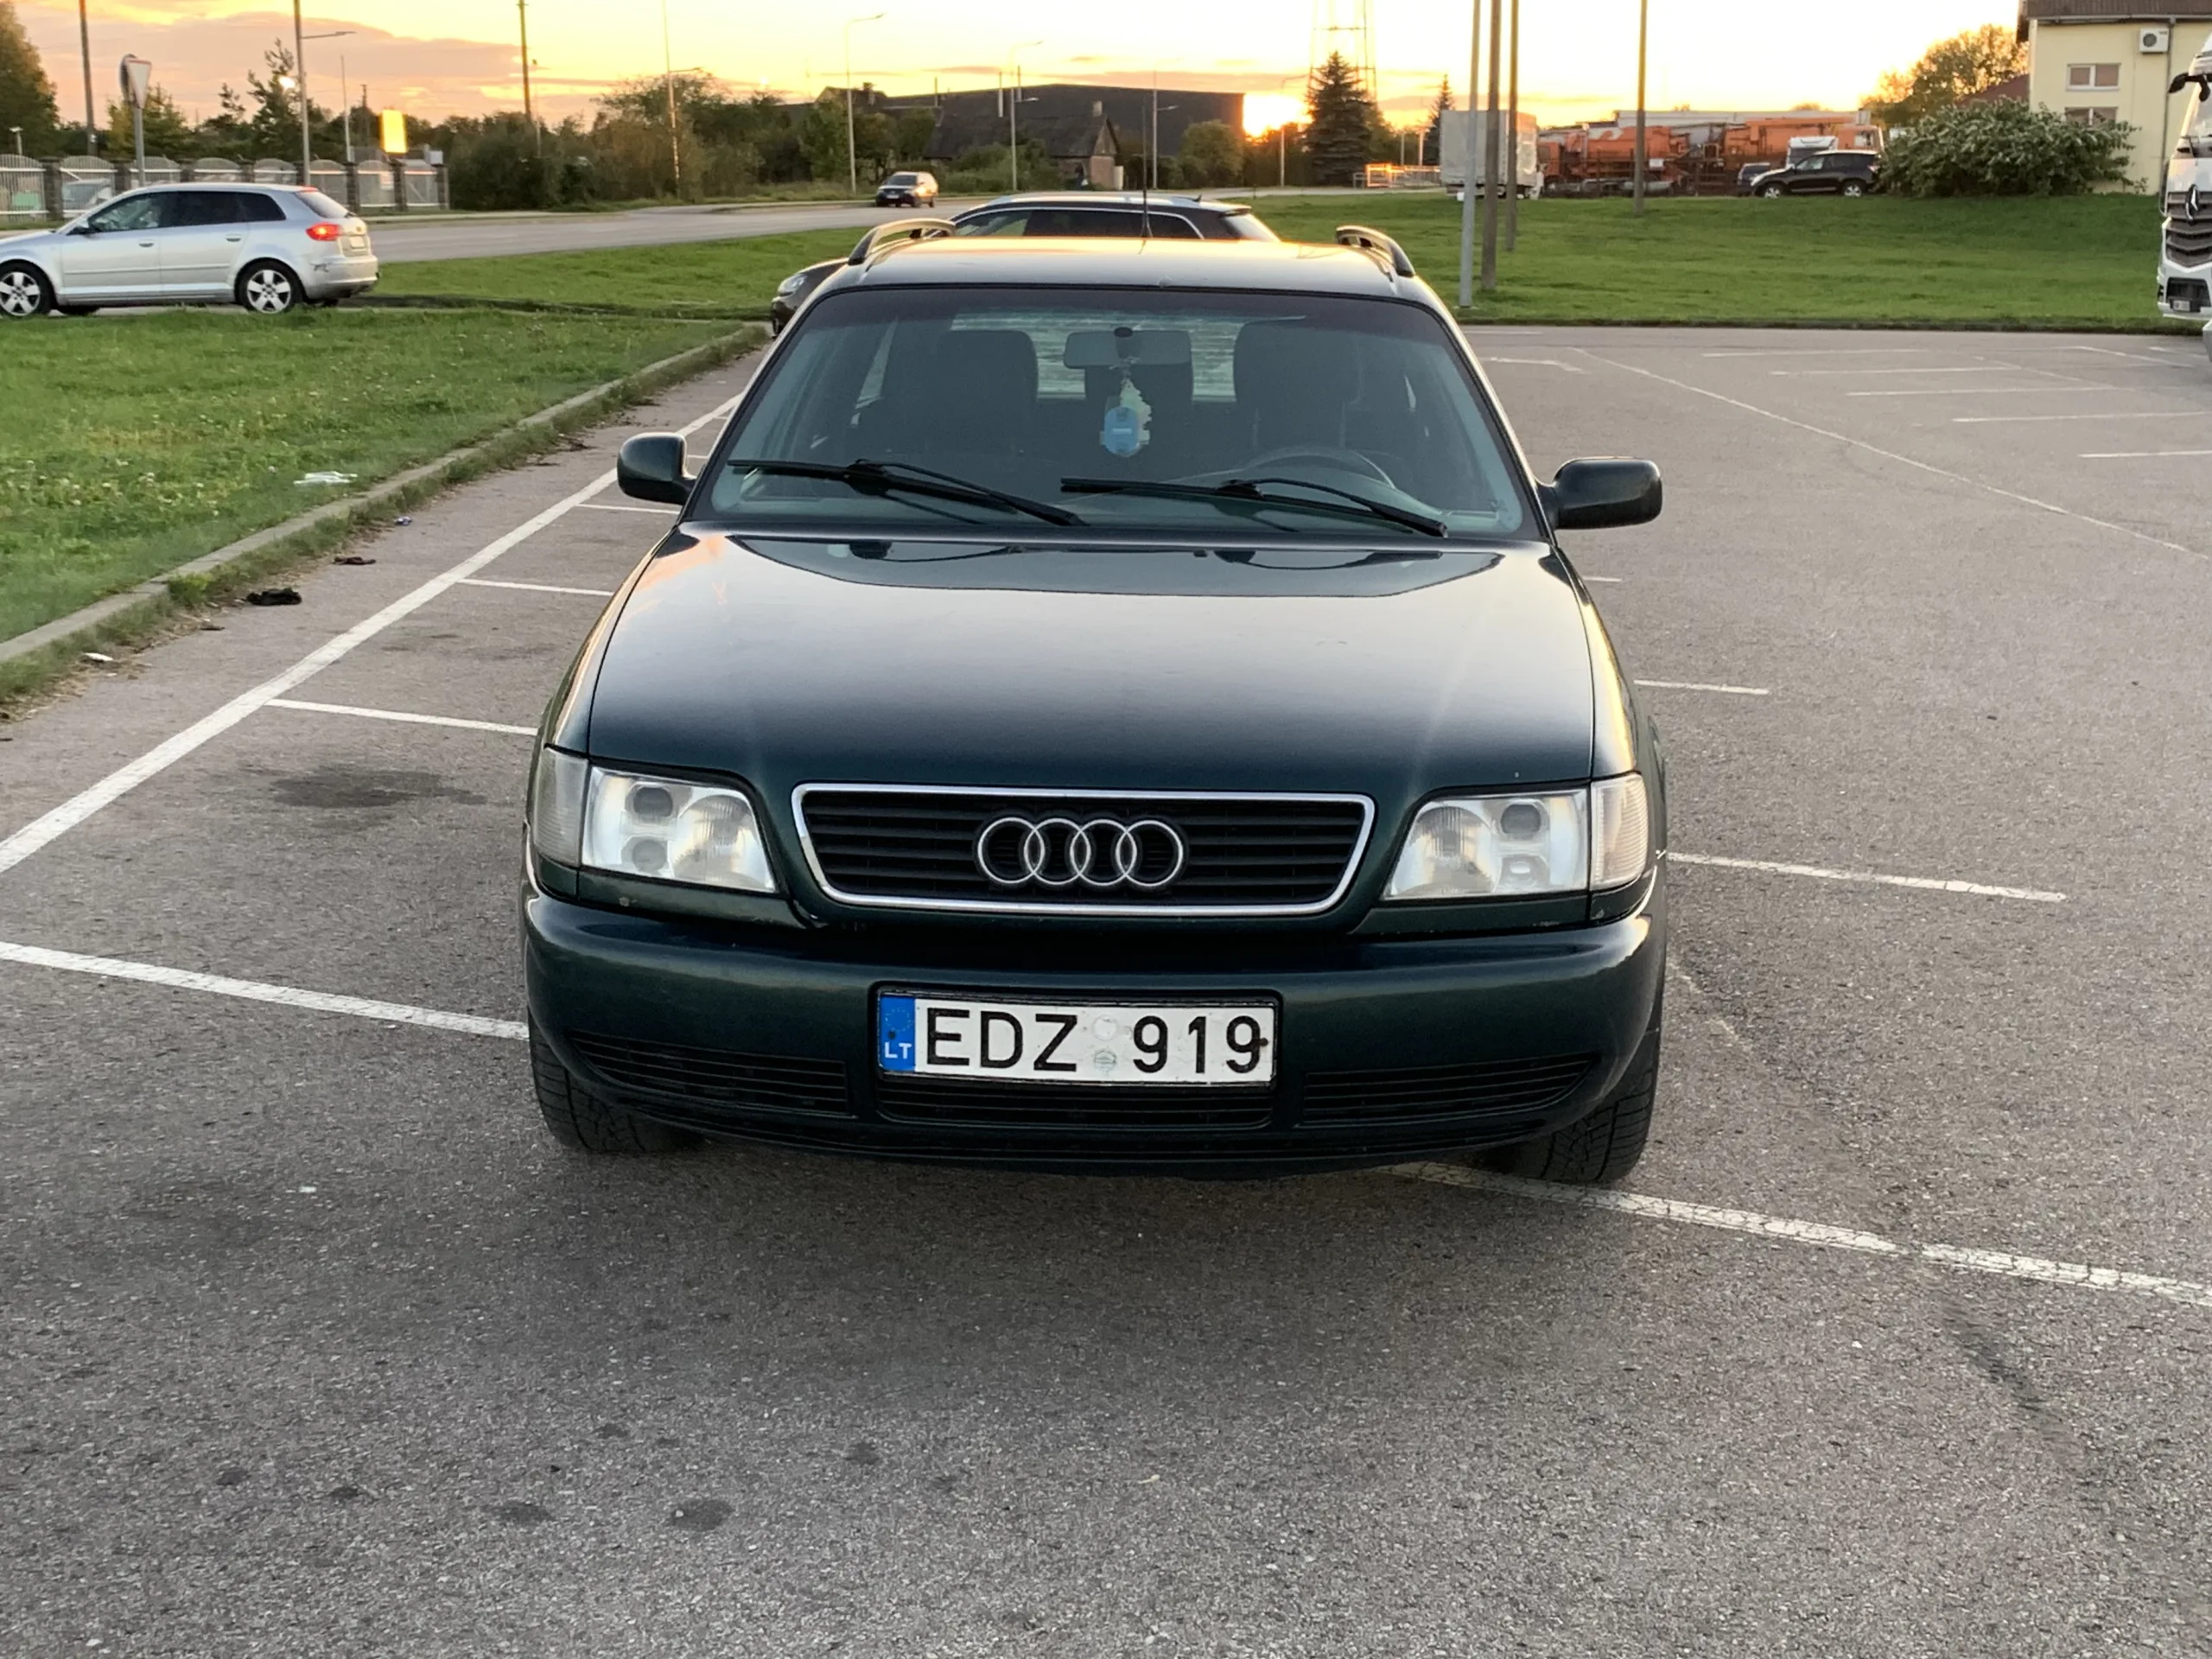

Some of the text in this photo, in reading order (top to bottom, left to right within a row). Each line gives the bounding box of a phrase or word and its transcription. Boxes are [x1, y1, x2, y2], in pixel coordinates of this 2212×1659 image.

[885, 1041, 912, 1059] LT
[926, 1007, 1262, 1074] EDZ 919
